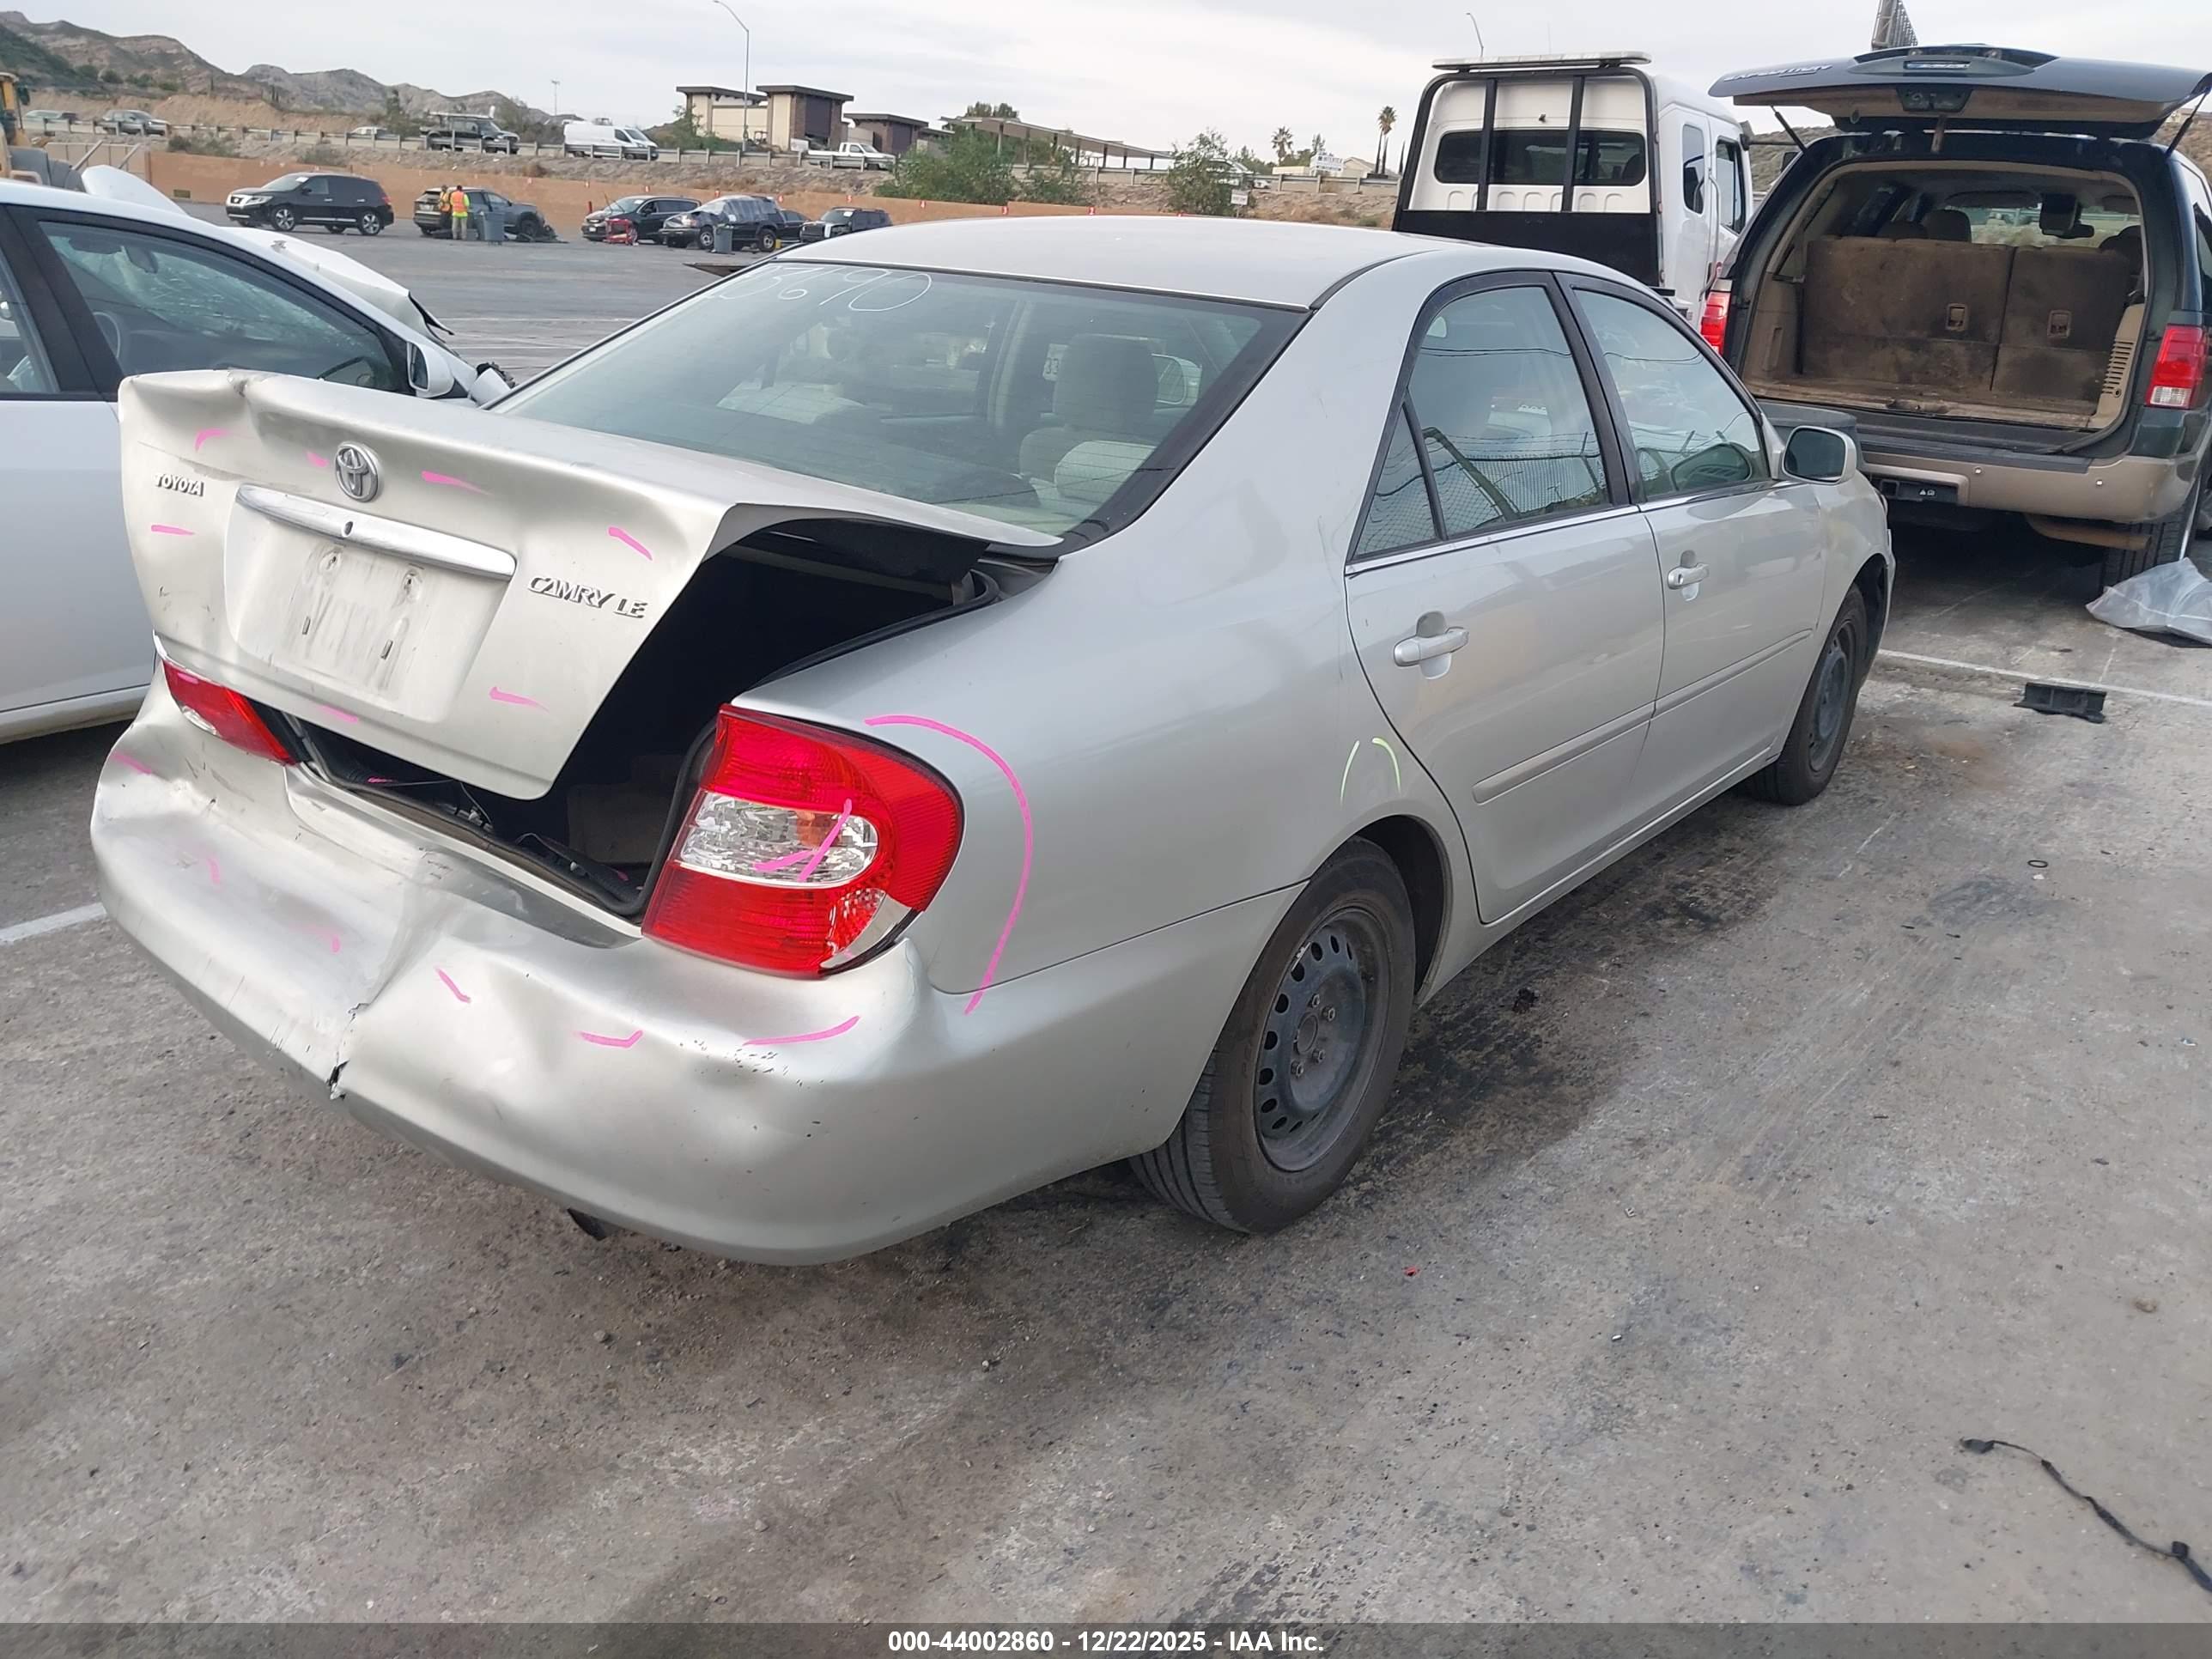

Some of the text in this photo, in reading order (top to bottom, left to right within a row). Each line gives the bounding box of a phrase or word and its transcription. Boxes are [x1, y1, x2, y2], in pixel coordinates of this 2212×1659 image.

[155, 473, 204, 497] TOYOTA
[527, 576, 648, 619] CAMRY LE
